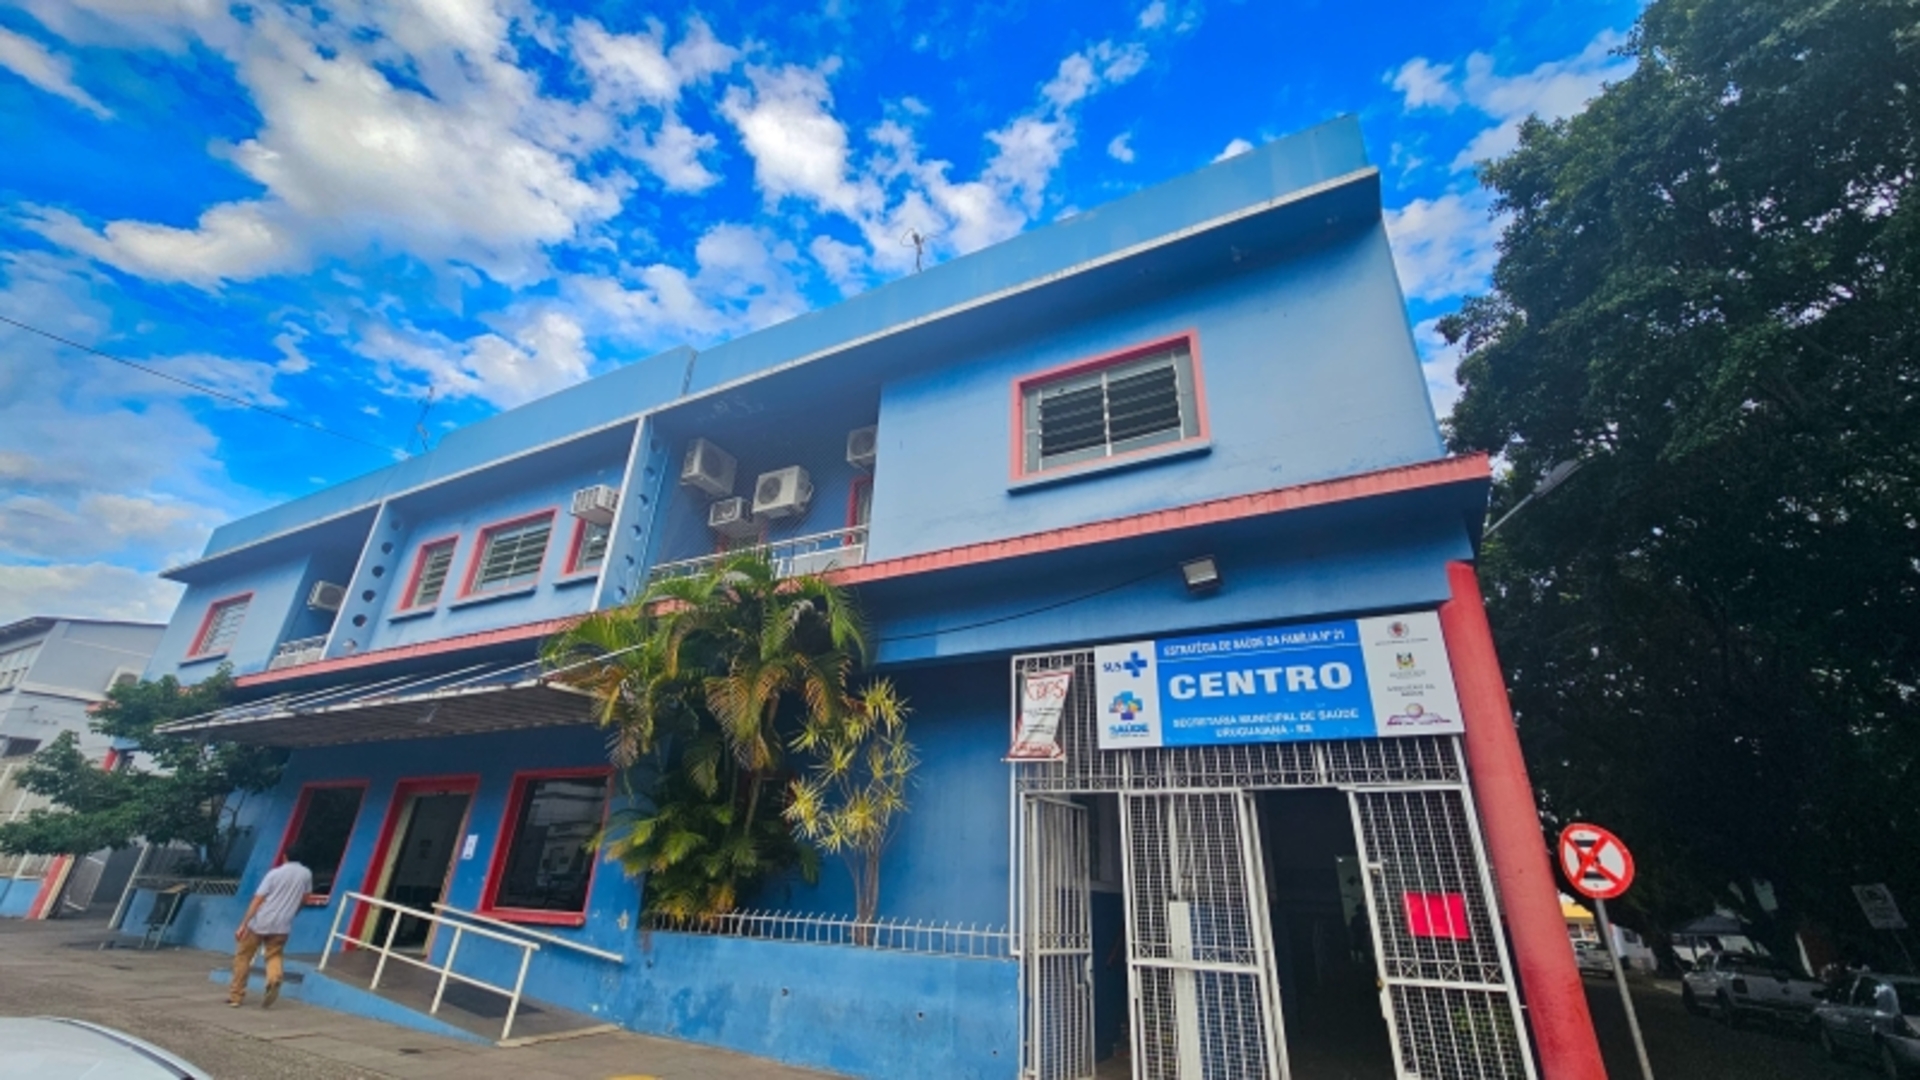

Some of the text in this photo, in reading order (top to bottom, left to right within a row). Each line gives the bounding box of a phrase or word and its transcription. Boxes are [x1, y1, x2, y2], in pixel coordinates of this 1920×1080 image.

[1163, 641, 1217, 656] ESTRATÉGIA
[1219, 639, 1232, 651] DE
[1233, 635, 1265, 650] SAÚDE
[1267, 634, 1280, 646] DA
[1281, 630, 1320, 644] FAMÍLIA
[1102, 661, 1122, 673] SUS
[1168, 661, 1353, 700] CENTRO
[1173, 707, 1359, 728] SECRETARIA MUNICIPAL DE SAÚDE
[1215, 724, 1289, 738] URUGUAIANA
[1296, 723, 1314, 734] RS
